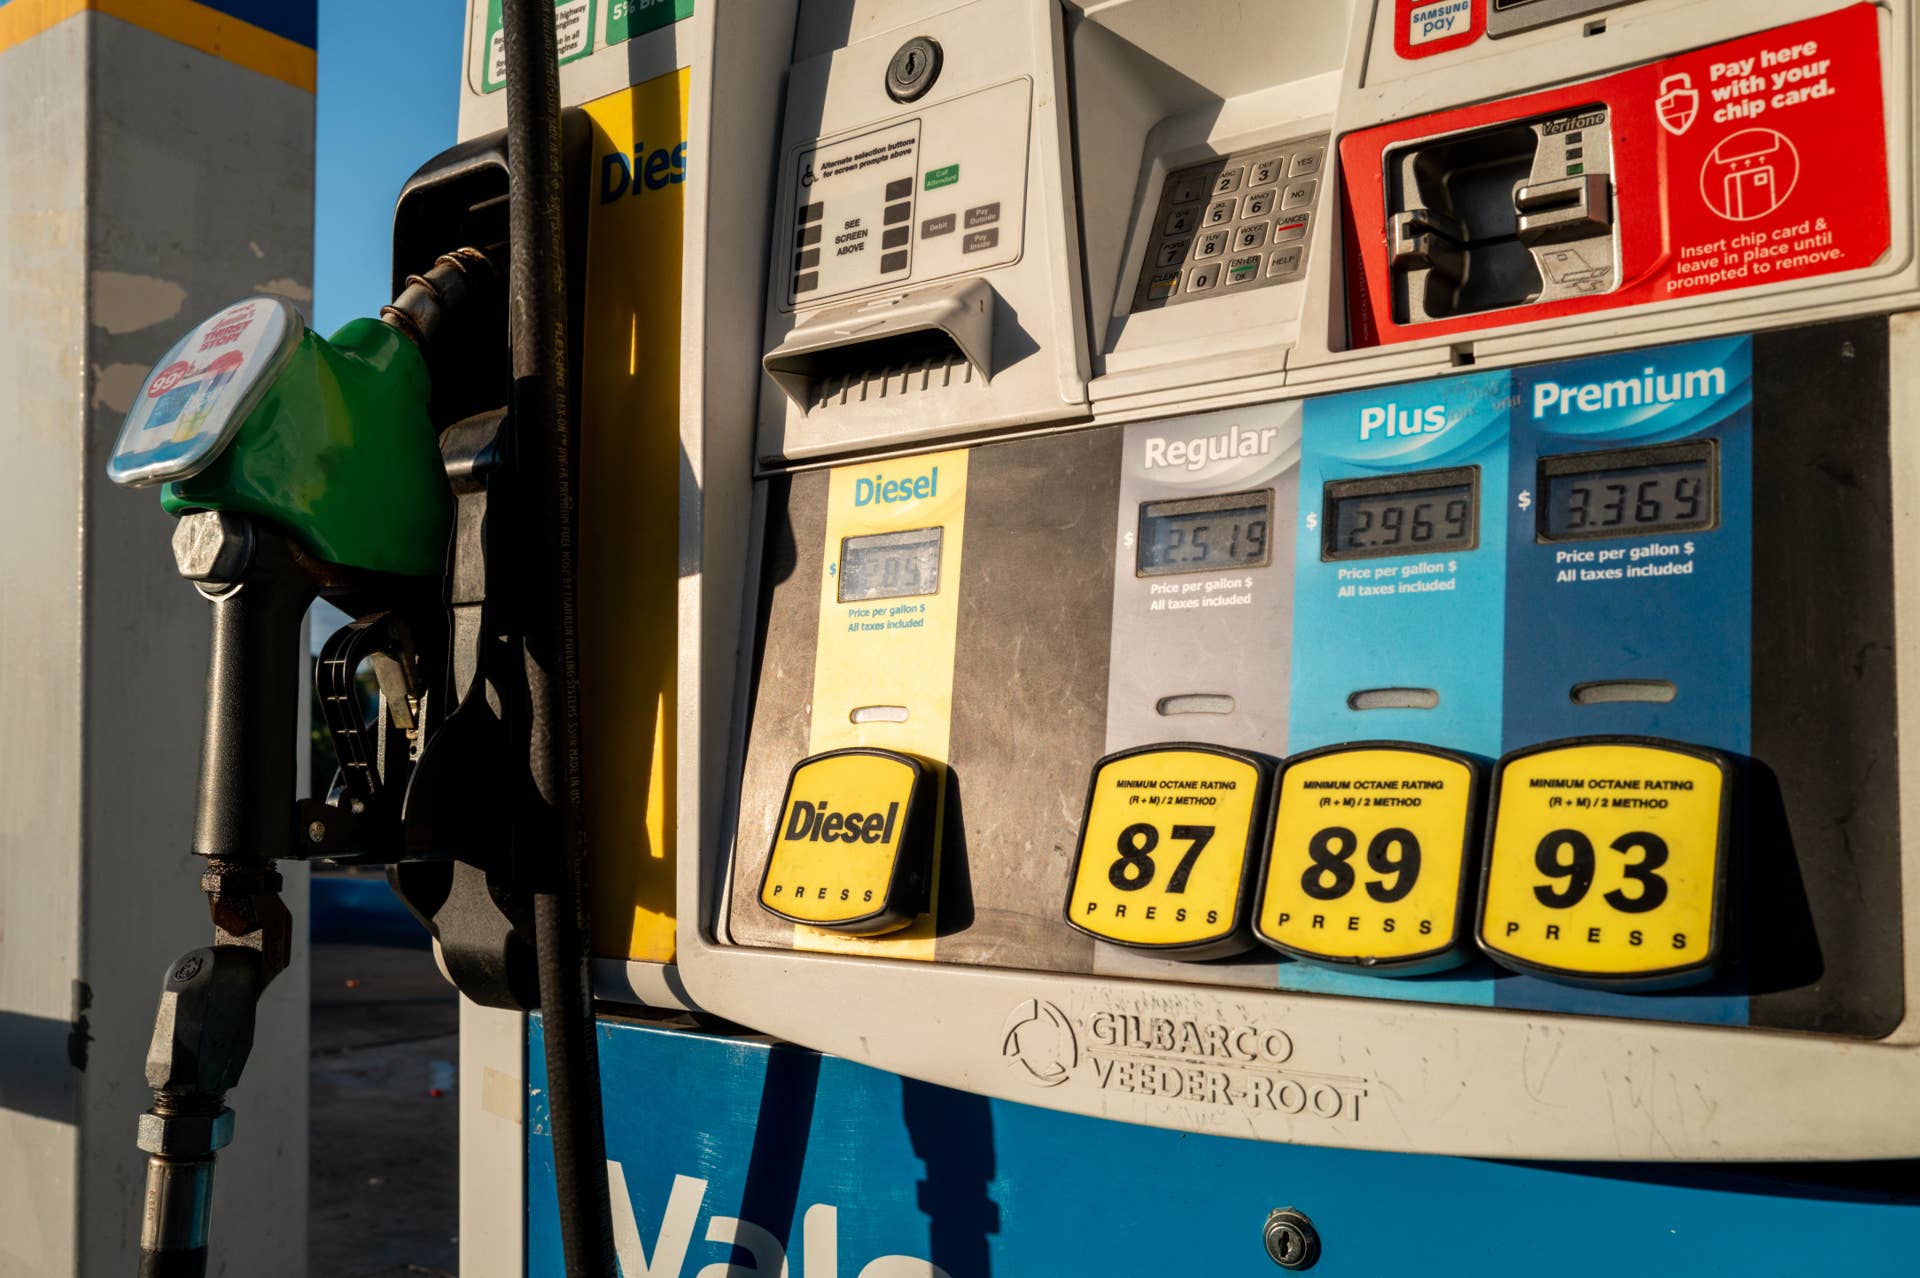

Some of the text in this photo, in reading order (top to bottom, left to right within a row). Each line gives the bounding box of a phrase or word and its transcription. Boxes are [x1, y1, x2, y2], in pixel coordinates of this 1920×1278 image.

[1413, 1, 1468, 23] SAMSUNG
[1423, 16, 1455, 37] pay
[1710, 41, 1818, 81] Pay here
[1711, 59, 1831, 102] with your
[1713, 78, 1836, 123] chip card.
[1542, 113, 1605, 135] Verifone
[821, 138, 915, 170] Alternate selection buttons
[1296, 157, 1313, 166] YES
[823, 148, 912, 178] for screen prompts above
[1258, 170, 1268, 182] 3
[1220, 179, 1230, 191] 2
[1291, 190, 1304, 199] NO
[1251, 201, 1262, 213] 6
[844, 218, 861, 230] SEE
[1175, 218, 1184, 229] 4
[1212, 210, 1222, 222] 5
[1278, 214, 1308, 226] CANCEL
[835, 229, 868, 245] SCREEN
[1244, 234, 1254, 246] 9
[1681, 217, 1828, 258] Insert chip card &
[837, 242, 865, 257] ABOVE
[1167, 250, 1177, 262] 7
[1204, 243, 1215, 254] 8
[1677, 232, 1833, 274] leave in place until
[1231, 255, 1258, 267] ENTER
[1272, 256, 1295, 266] HELP
[1235, 272, 1246, 281] OK
[1666, 248, 1845, 292] prompted to remove.
[1197, 276, 1207, 287] 0
[1533, 367, 1726, 419] Premium
[1360, 403, 1446, 441] Plus
[1144, 425, 1279, 471] Regular
[855, 466, 938, 507] Diesel
[1518, 477, 1702, 529] $ 3.369
[1306, 498, 1468, 547] $ 2.969
[1124, 531, 1134, 548] $
[1556, 541, 1695, 564] Price per gallon $
[829, 562, 837, 578] $
[1338, 560, 1457, 580] Price per gallon $
[1556, 561, 1693, 583] All taxes included
[1151, 577, 1253, 595] Price per gallon $
[1338, 578, 1456, 598] All taxes included
[1150, 593, 1252, 610] All taxes included
[849, 603, 926, 618] Price per gallon $
[848, 618, 924, 632] All taxes included
[1116, 780, 1236, 790] MINIMUM OCTANE RATING
[1303, 781, 1444, 790] MINIMUM OCTANE RATING
[1529, 778, 1693, 790] MINIMUM OCTANE RATING
[1175, 796, 1216, 806] METHOD
[1373, 798, 1421, 807] METHOD
[1612, 799, 1668, 809] METHOD
[784, 800, 899, 844] Diesel
[1108, 822, 1216, 894] 87
[1301, 826, 1421, 904] 89
[1533, 828, 1669, 914] 93
[1087, 1011, 1294, 1064] GILBARCO
[1089, 1055, 1369, 1121] VEEDER-ROOT
